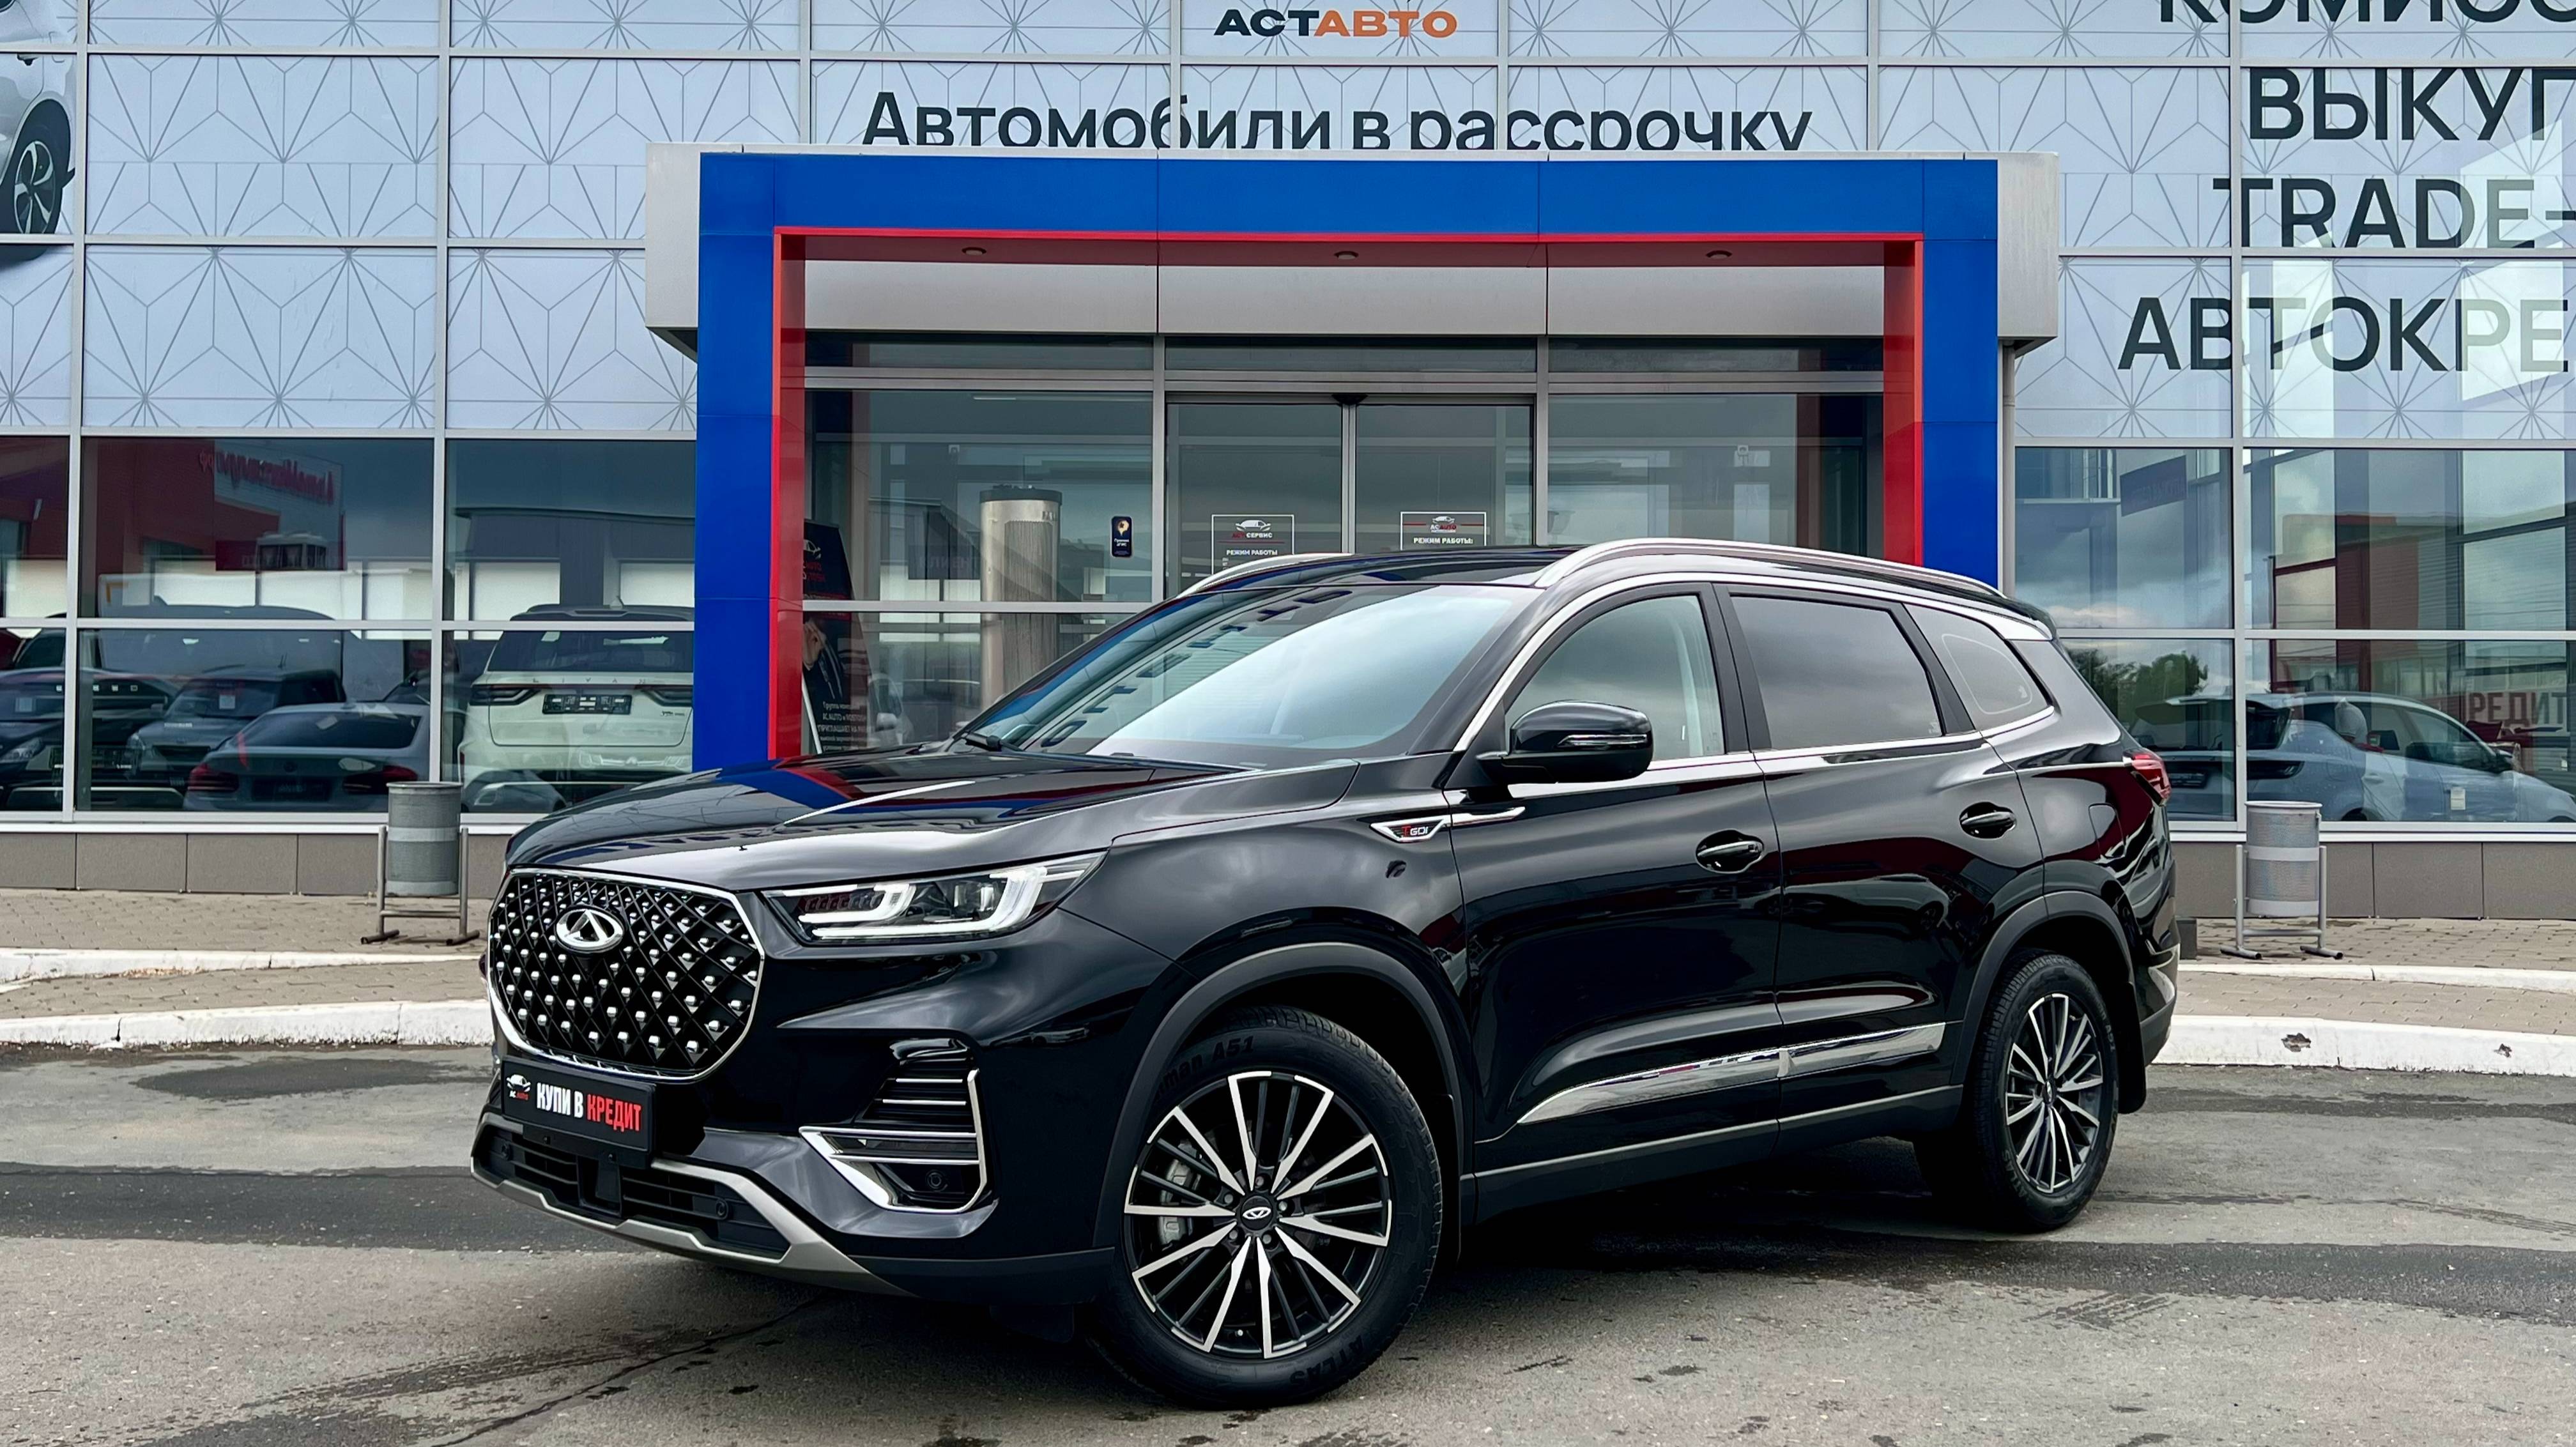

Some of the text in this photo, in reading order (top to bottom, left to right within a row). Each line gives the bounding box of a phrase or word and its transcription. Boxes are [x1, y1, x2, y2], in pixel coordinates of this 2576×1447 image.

[1215, 9, 1457, 38] АСТАВТО
[862, 92, 1330, 149] Автомобили
[1353, 111, 1391, 149] в
[1211, 1035, 1255, 1062] A51
[536, 1082, 642, 1133] КУПИ В КРЕДИТ
